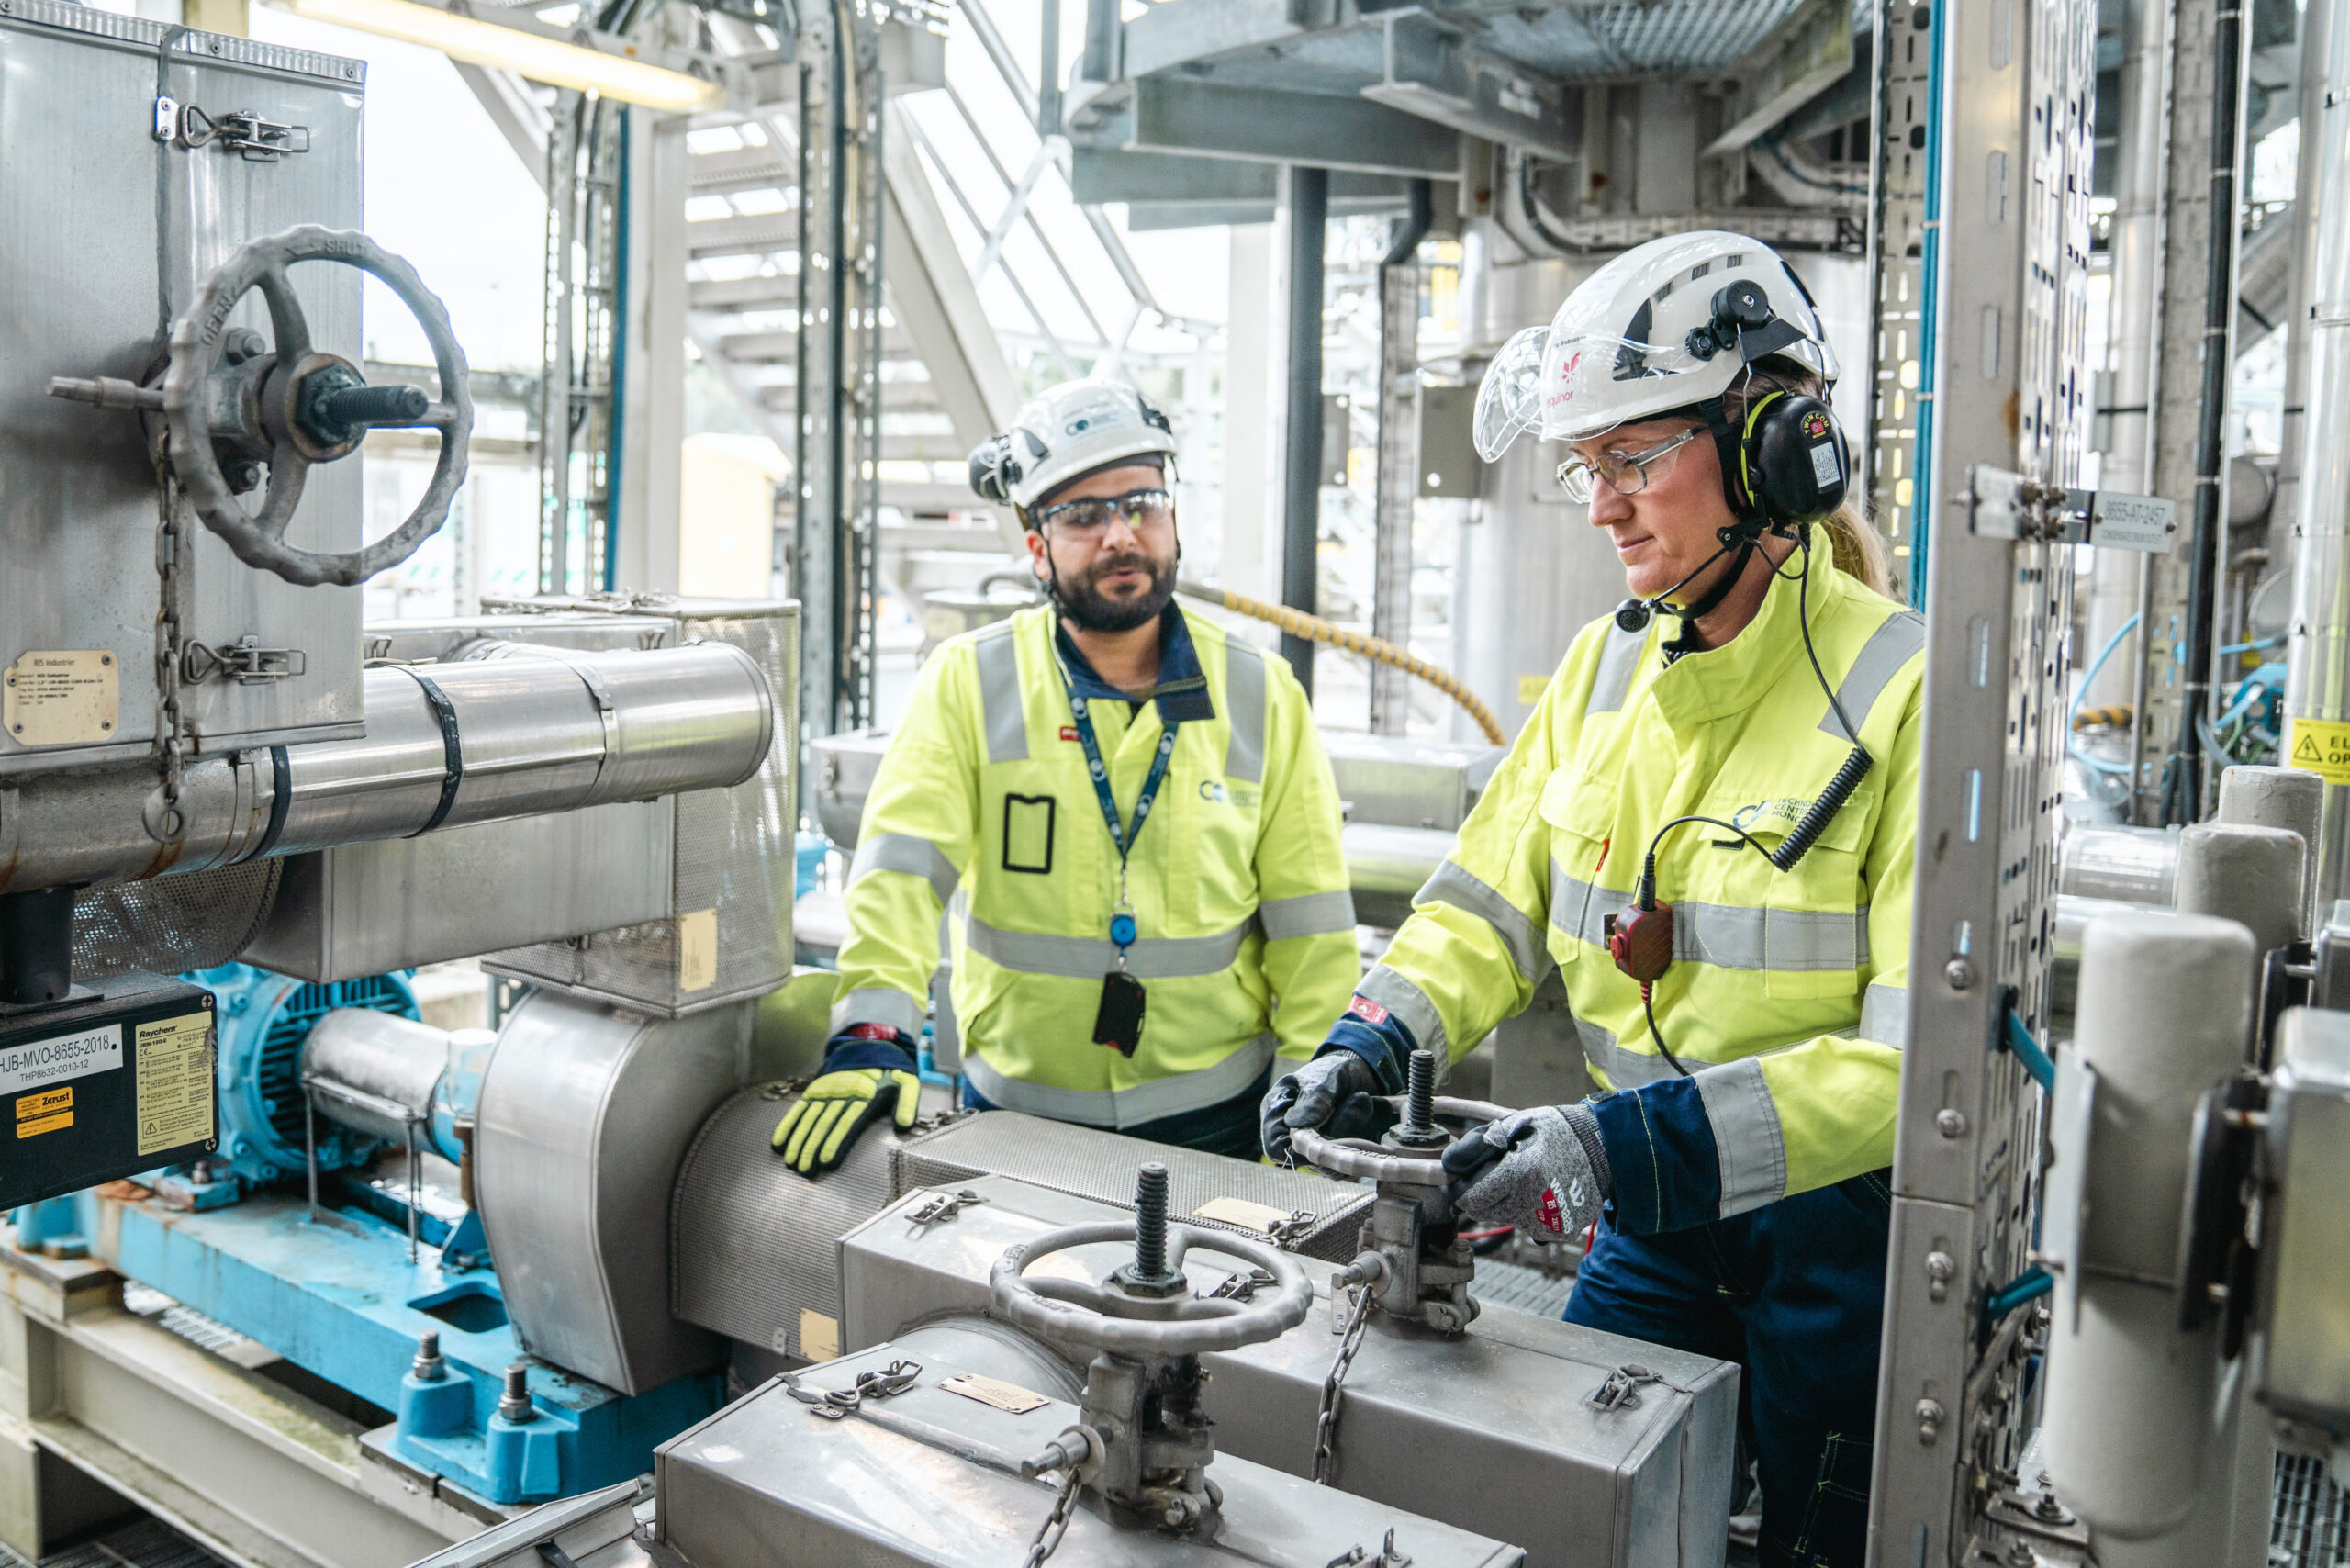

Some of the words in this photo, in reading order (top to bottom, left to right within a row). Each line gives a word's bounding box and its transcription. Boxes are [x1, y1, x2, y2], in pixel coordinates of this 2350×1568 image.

[1804, 413, 1814, 434] TWIN
[1815, 412, 1830, 428] COM
[1772, 810, 1802, 823] MONG
[140, 1025, 177, 1038] Raychem
[20, 1059, 89, 1082] THP8632-0010-12
[42, 1092, 70, 1105] Zerust
[1550, 1177, 1574, 1235] wenaas
